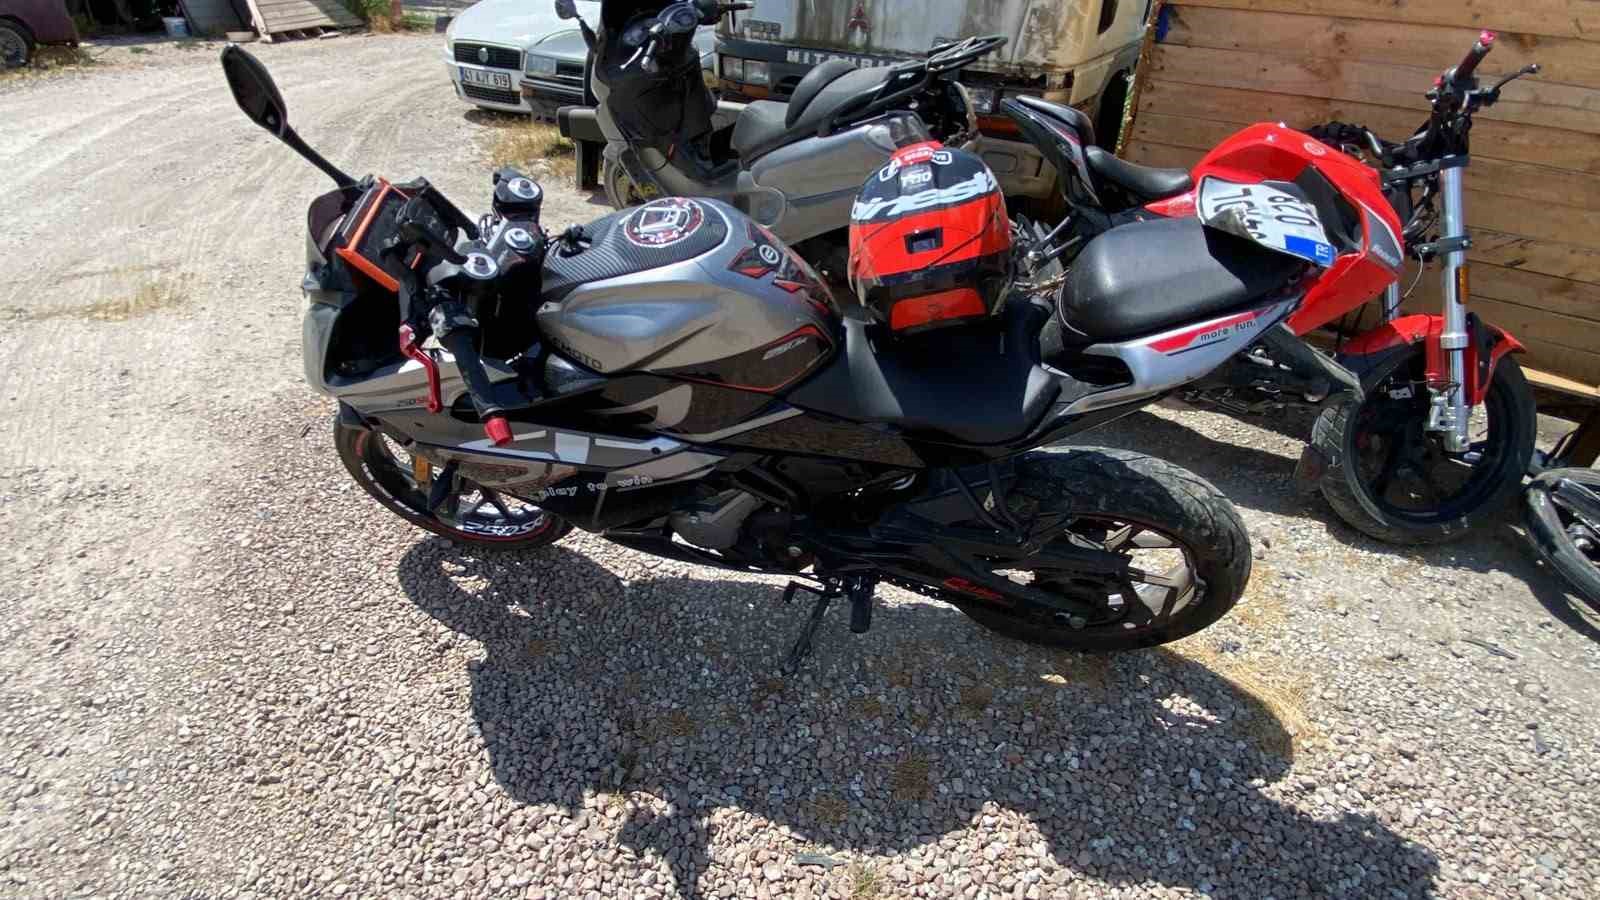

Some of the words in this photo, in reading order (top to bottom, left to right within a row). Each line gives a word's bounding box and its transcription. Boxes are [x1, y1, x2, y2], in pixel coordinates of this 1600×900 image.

[1315, 243, 1330, 259] TR
[1200, 327, 1229, 341] more
[586, 481, 608, 493] to
[617, 474, 654, 489] win
